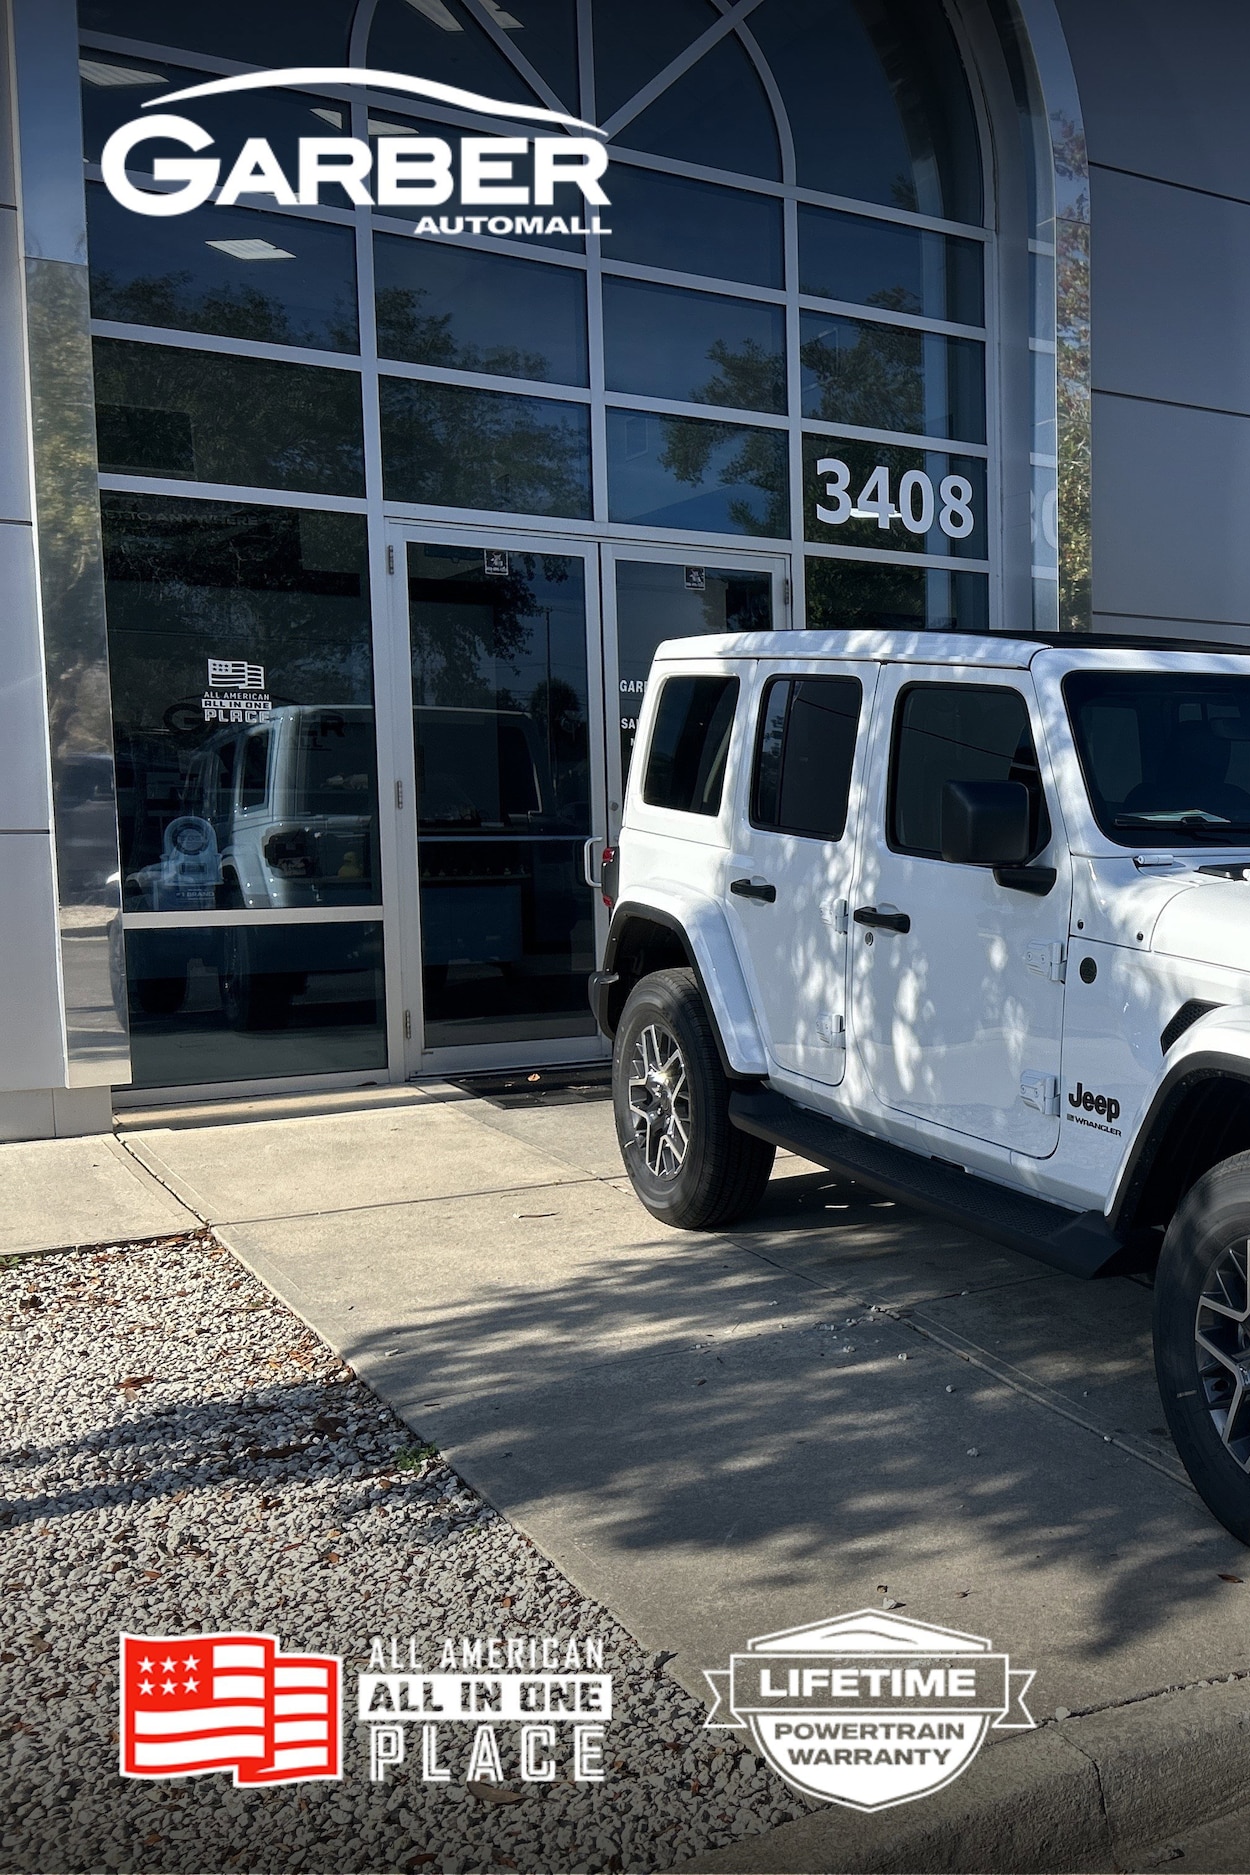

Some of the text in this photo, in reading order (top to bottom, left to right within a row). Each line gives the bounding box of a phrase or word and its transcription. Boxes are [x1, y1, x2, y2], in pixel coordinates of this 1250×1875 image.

[816, 457, 975, 539] 3408
[203, 691, 270, 701] ALL AMERICAN
[204, 708, 270, 723] PLACE
[1068, 1082, 1121, 1123] Jeep
[1074, 1115, 1122, 1138] WRANGLER
